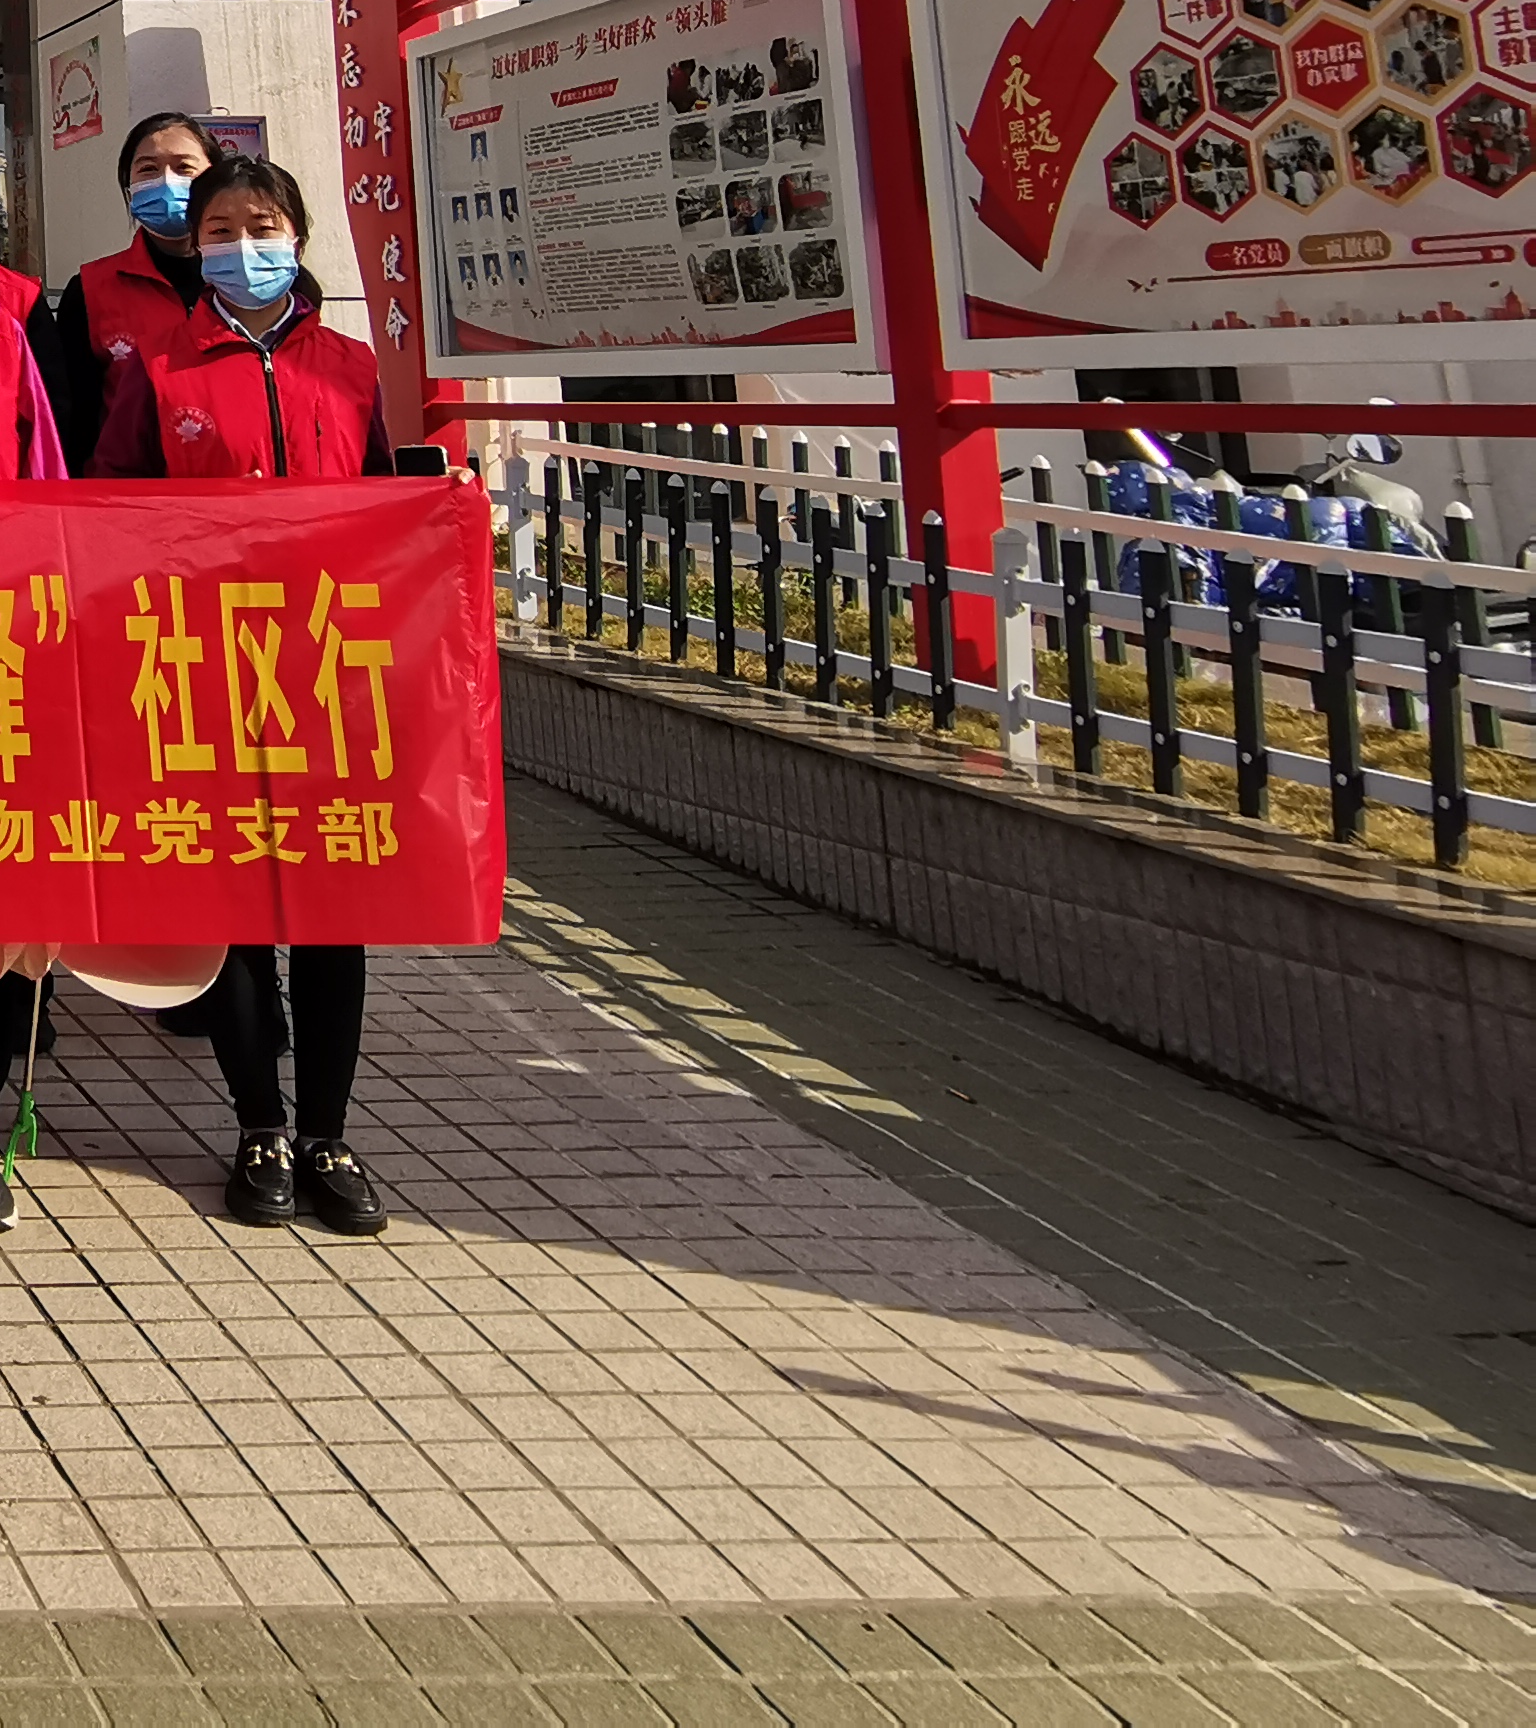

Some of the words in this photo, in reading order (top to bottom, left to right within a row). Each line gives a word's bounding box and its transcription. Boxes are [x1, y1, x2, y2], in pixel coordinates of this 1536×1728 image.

[1000, 55, 1061, 153] 永远
[374, 101, 409, 351] 牢记使命
[126, 571, 393, 782] 社区行
